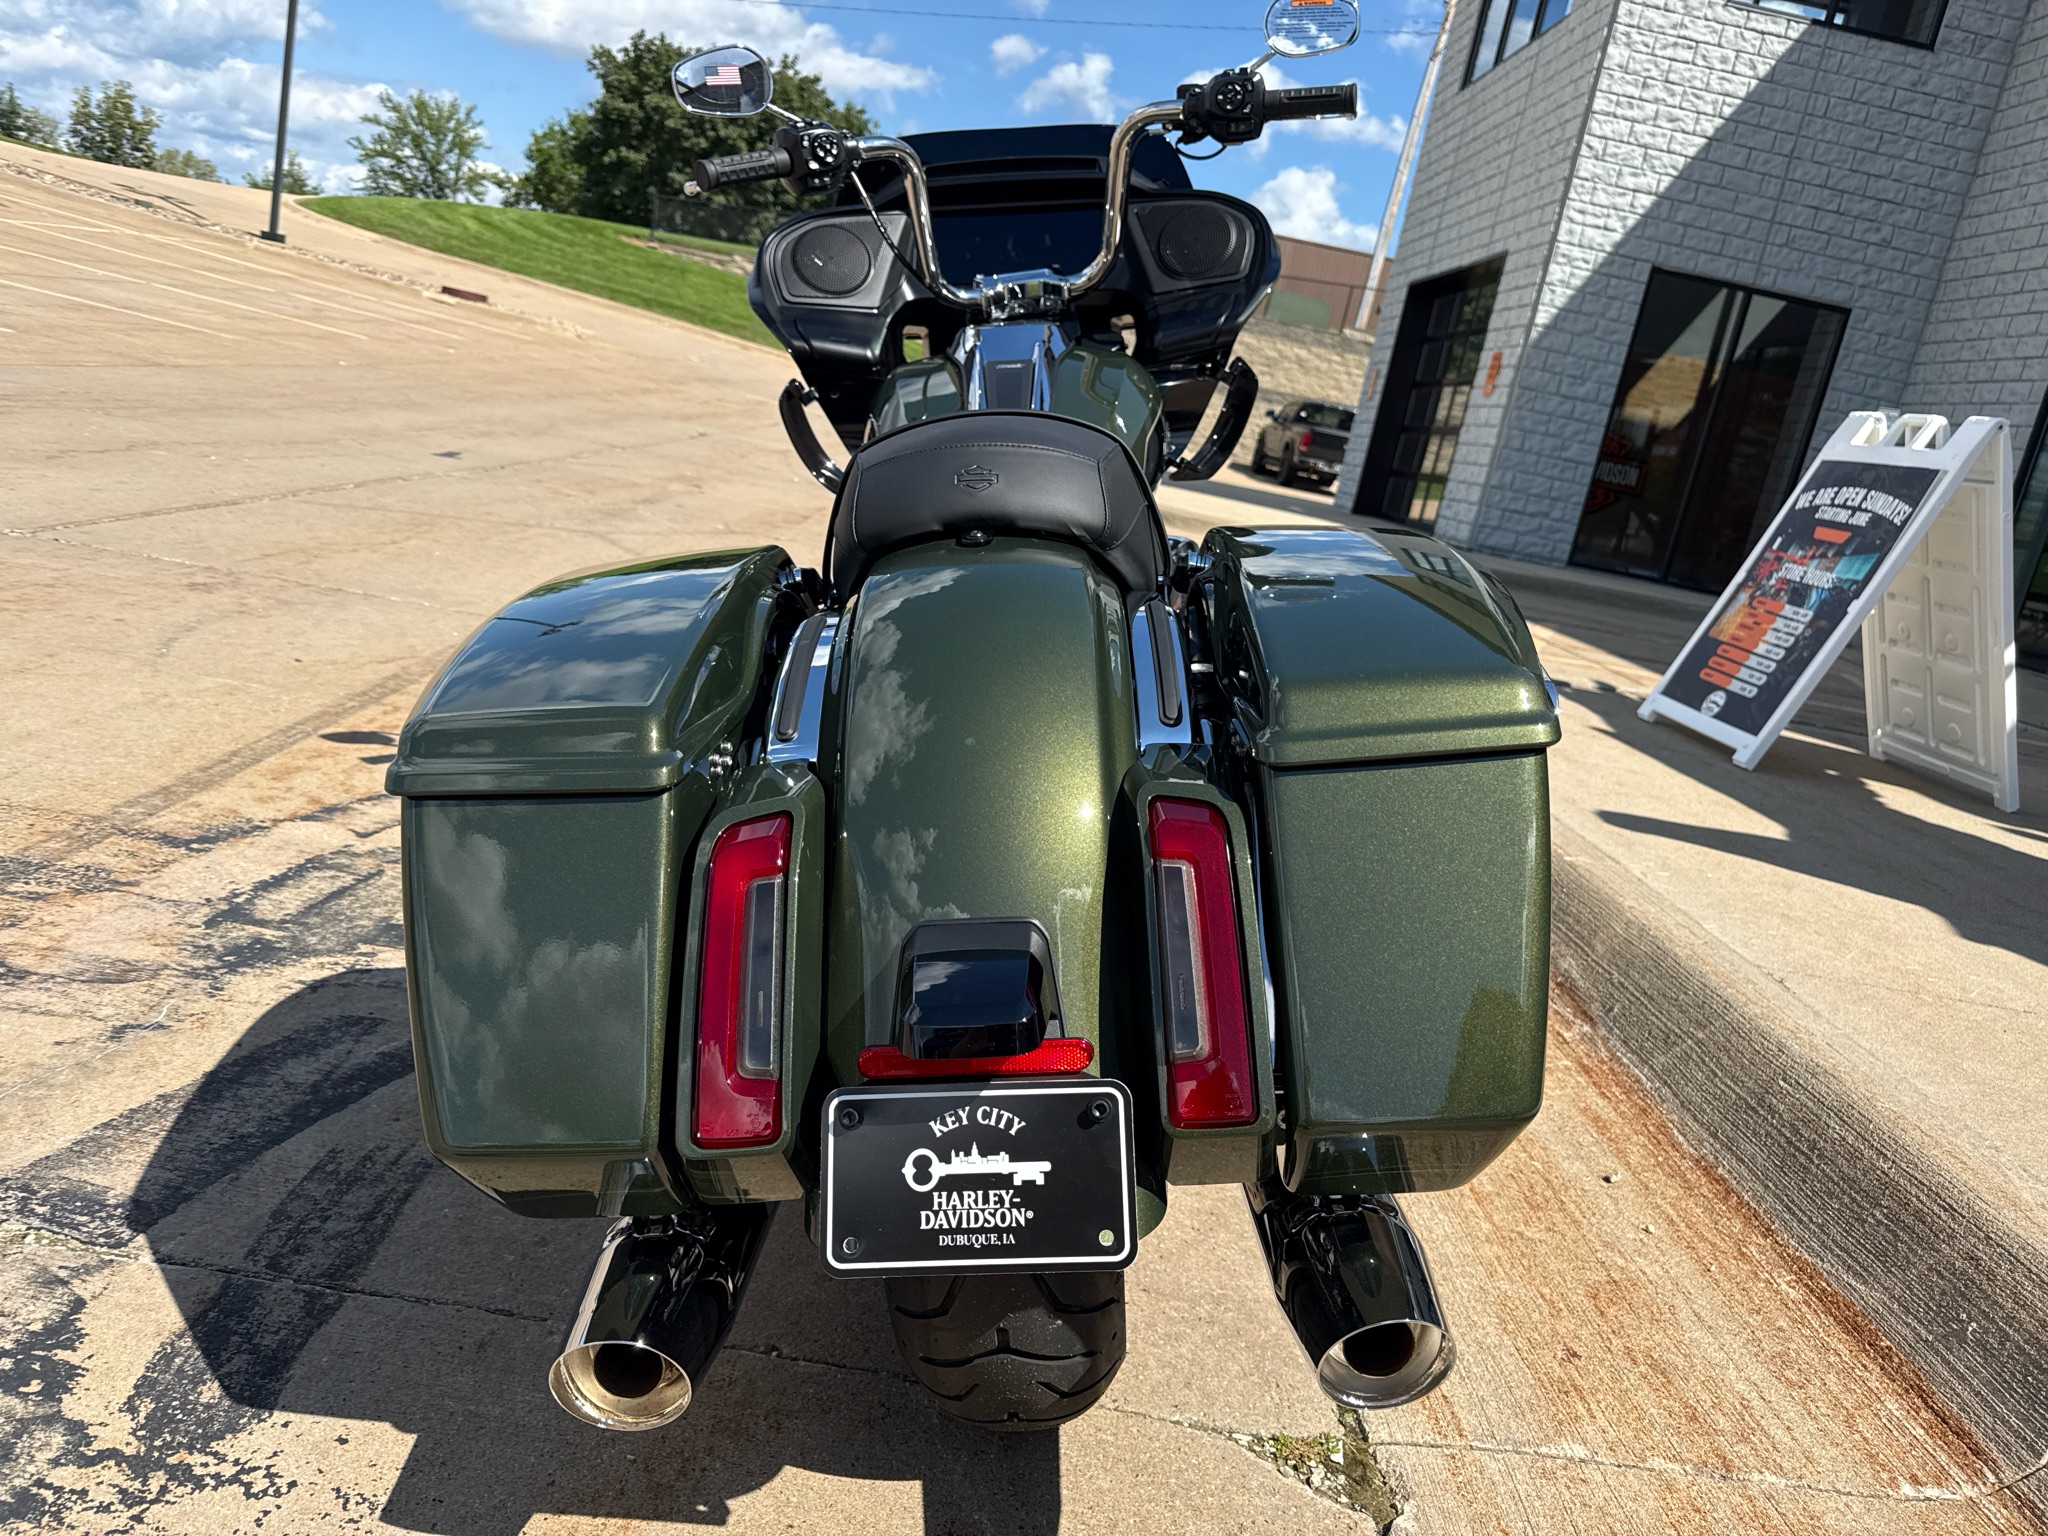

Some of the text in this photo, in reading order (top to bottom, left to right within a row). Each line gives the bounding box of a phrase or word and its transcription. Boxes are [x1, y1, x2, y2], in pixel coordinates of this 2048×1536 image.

[1796, 486, 1912, 526] WE ARE OPEN SUNDAYS!
[1814, 505, 1873, 527] STARTING JUNE
[1778, 562, 1807, 582] STORE
[928, 1105, 1026, 1138] KEY CITY
[932, 1189, 1021, 1210] HARLEY-
[938, 1233, 1016, 1248] DUBUQUE, IA
